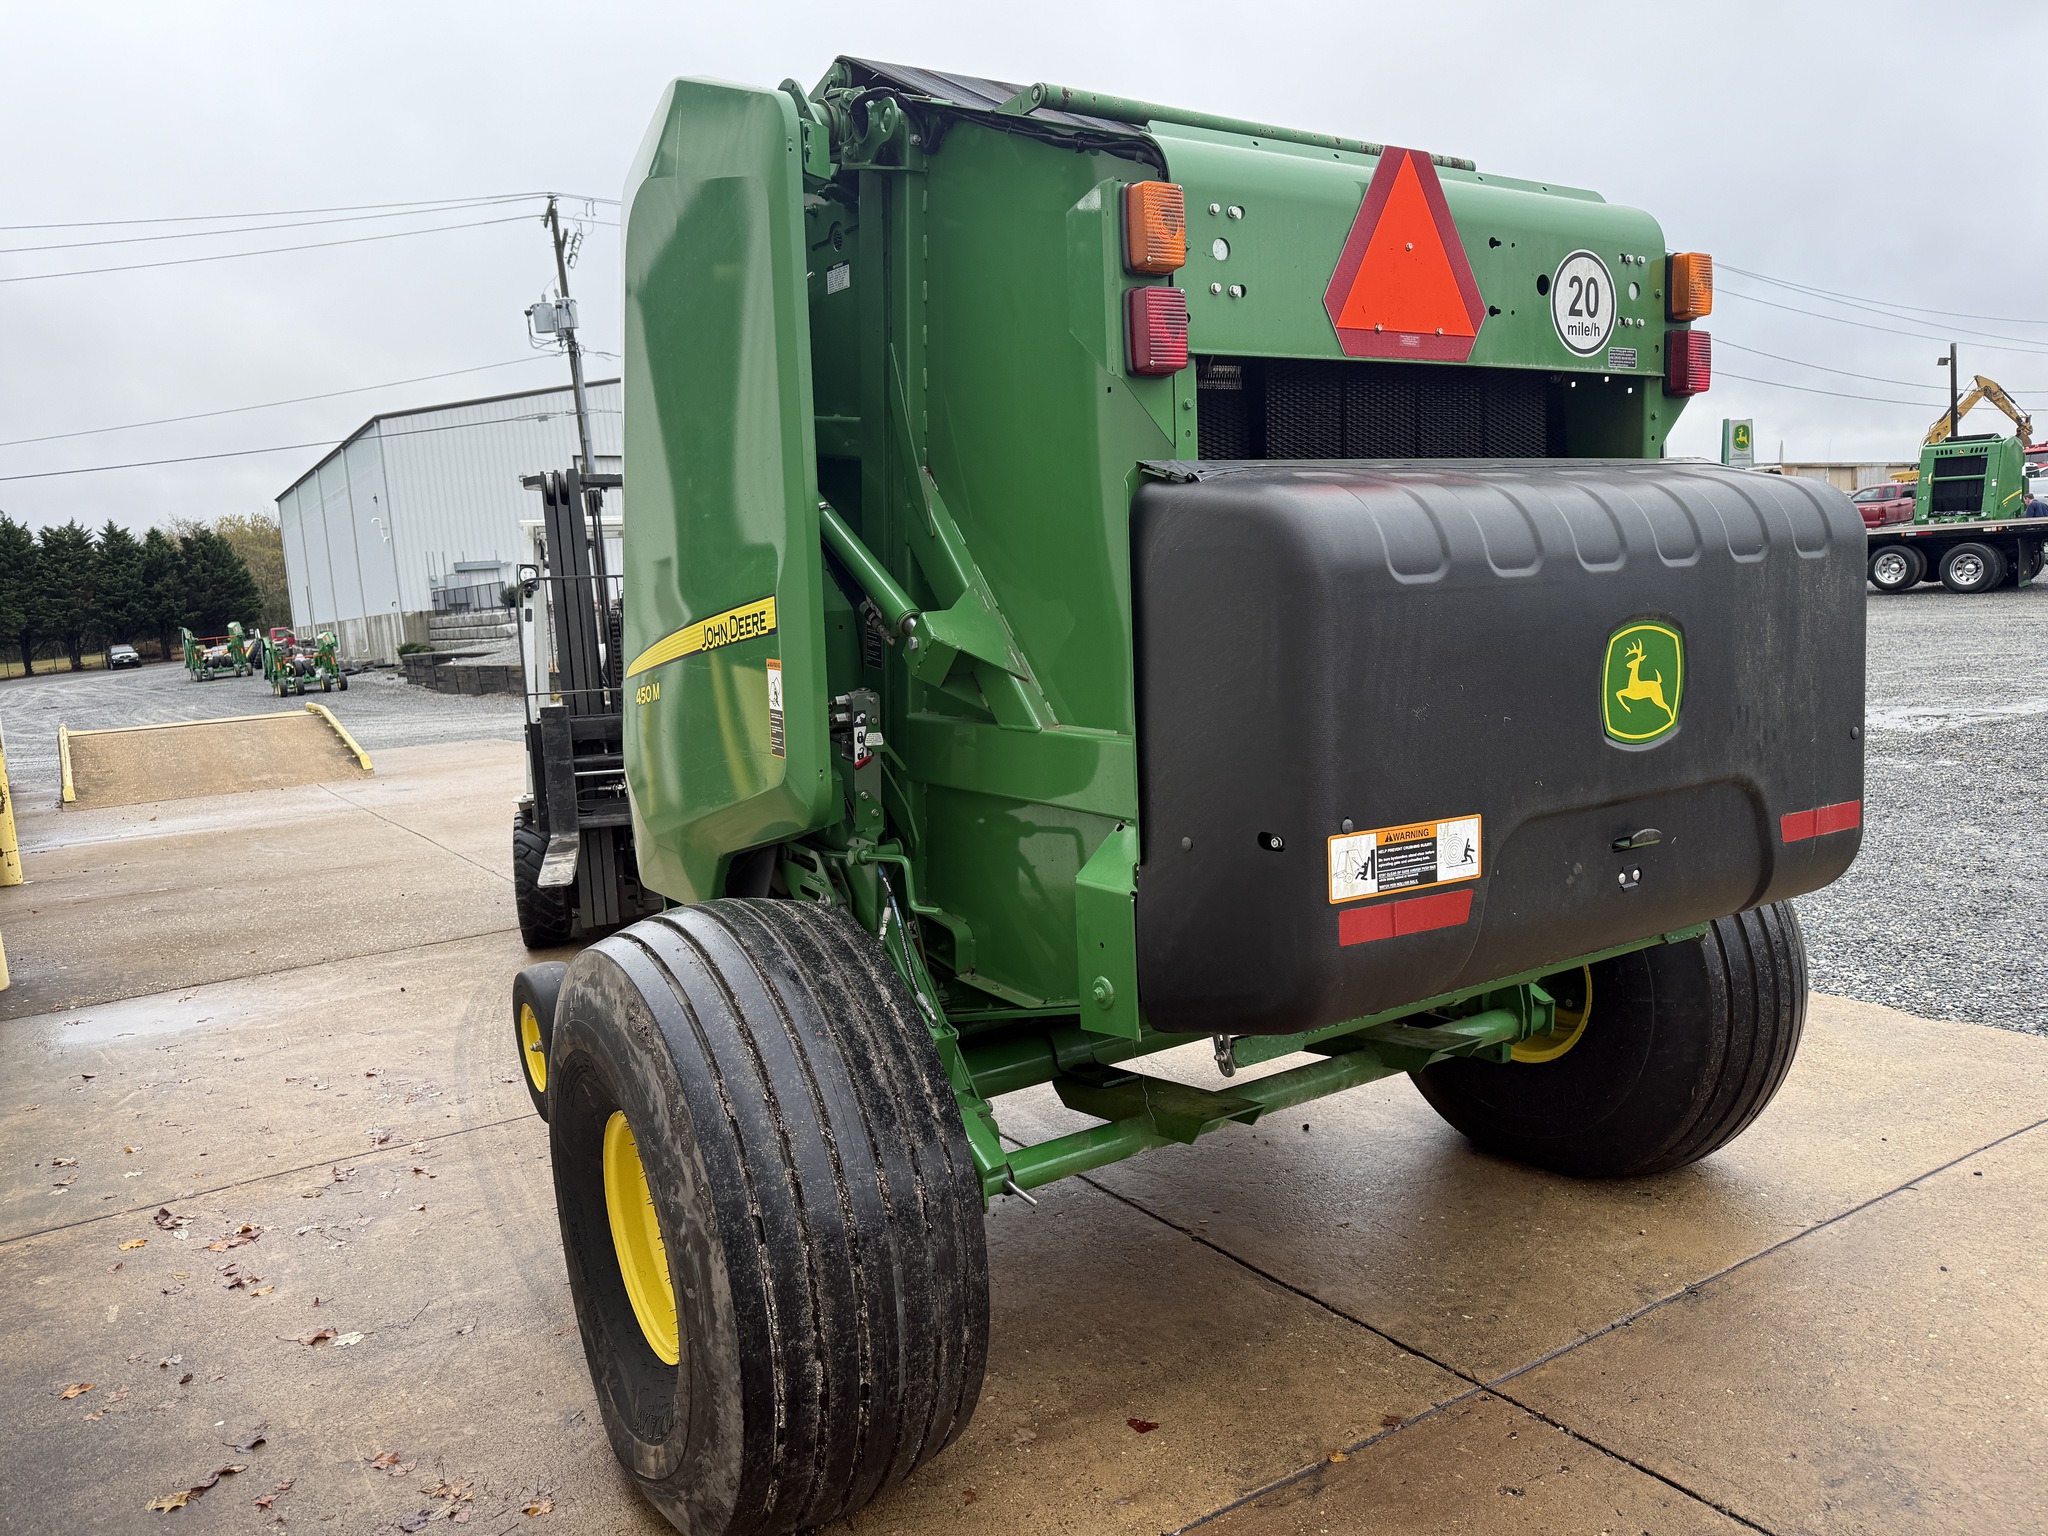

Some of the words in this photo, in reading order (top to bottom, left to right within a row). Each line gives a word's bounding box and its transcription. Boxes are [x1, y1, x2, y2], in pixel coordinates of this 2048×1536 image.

[1568, 275, 1600, 318] 20
[1567, 321, 1600, 337] mile/h
[701, 622, 728, 648] JOHN
[729, 610, 767, 639] DEERE
[635, 684, 652, 705] 450
[652, 682, 660, 701] M
[1393, 828, 1429, 841] WARNING
